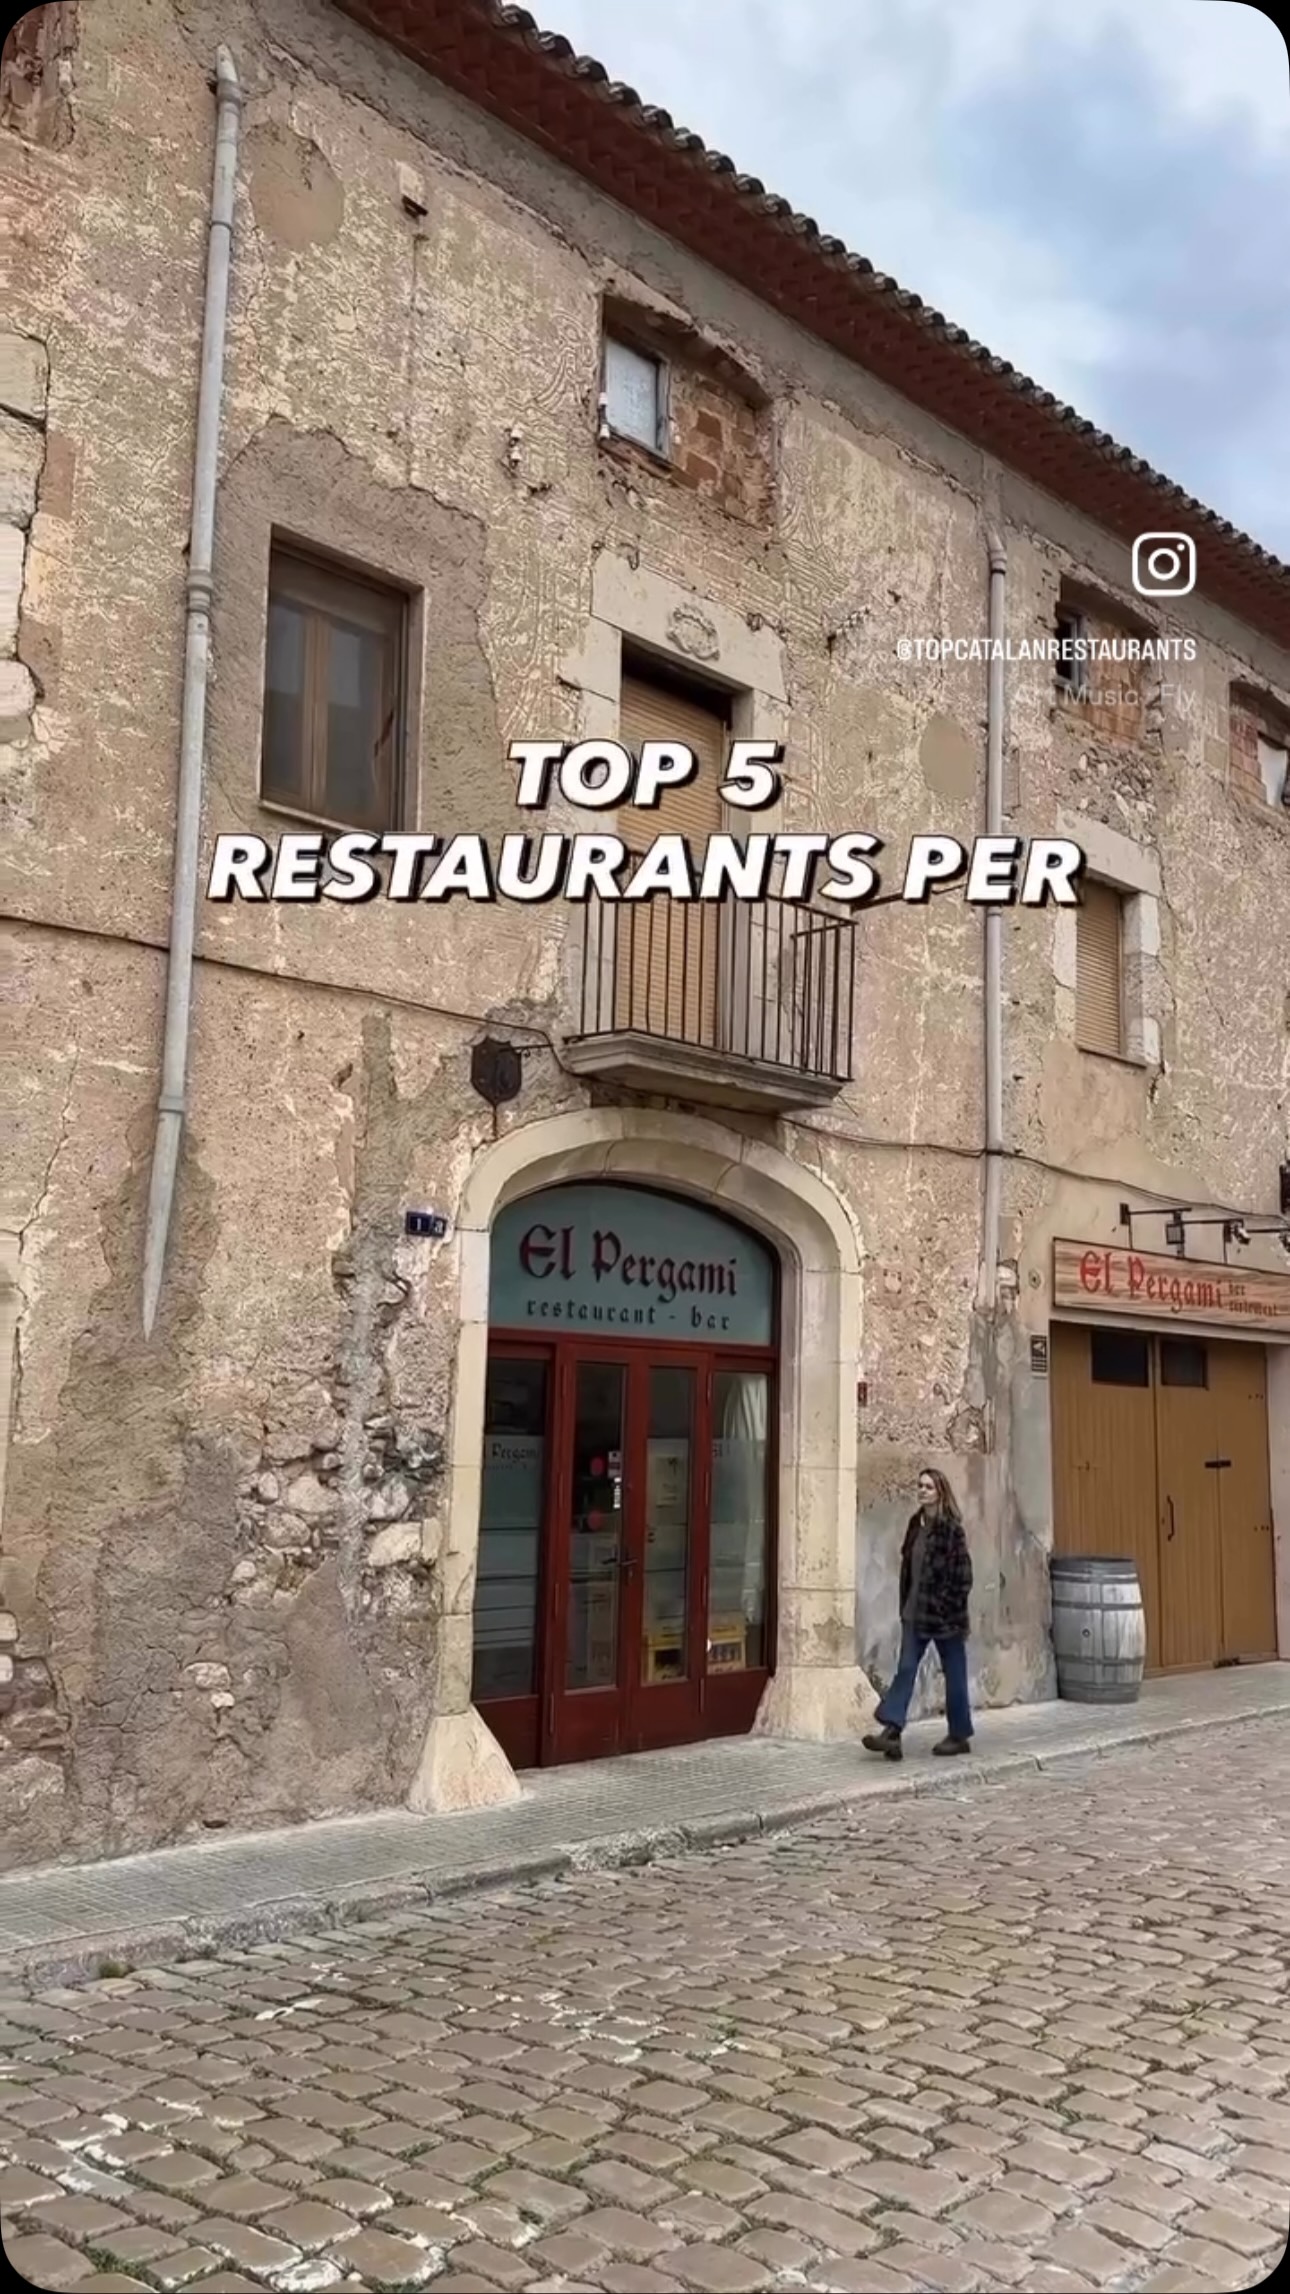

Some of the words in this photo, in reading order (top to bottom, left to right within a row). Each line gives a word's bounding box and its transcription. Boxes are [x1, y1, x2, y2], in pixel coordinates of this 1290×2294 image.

[519, 1223, 576, 1280] El
[1080, 1250, 1114, 1295] El
[527, 1300, 656, 1325] restaurant
[691, 1305, 730, 1331] bar
